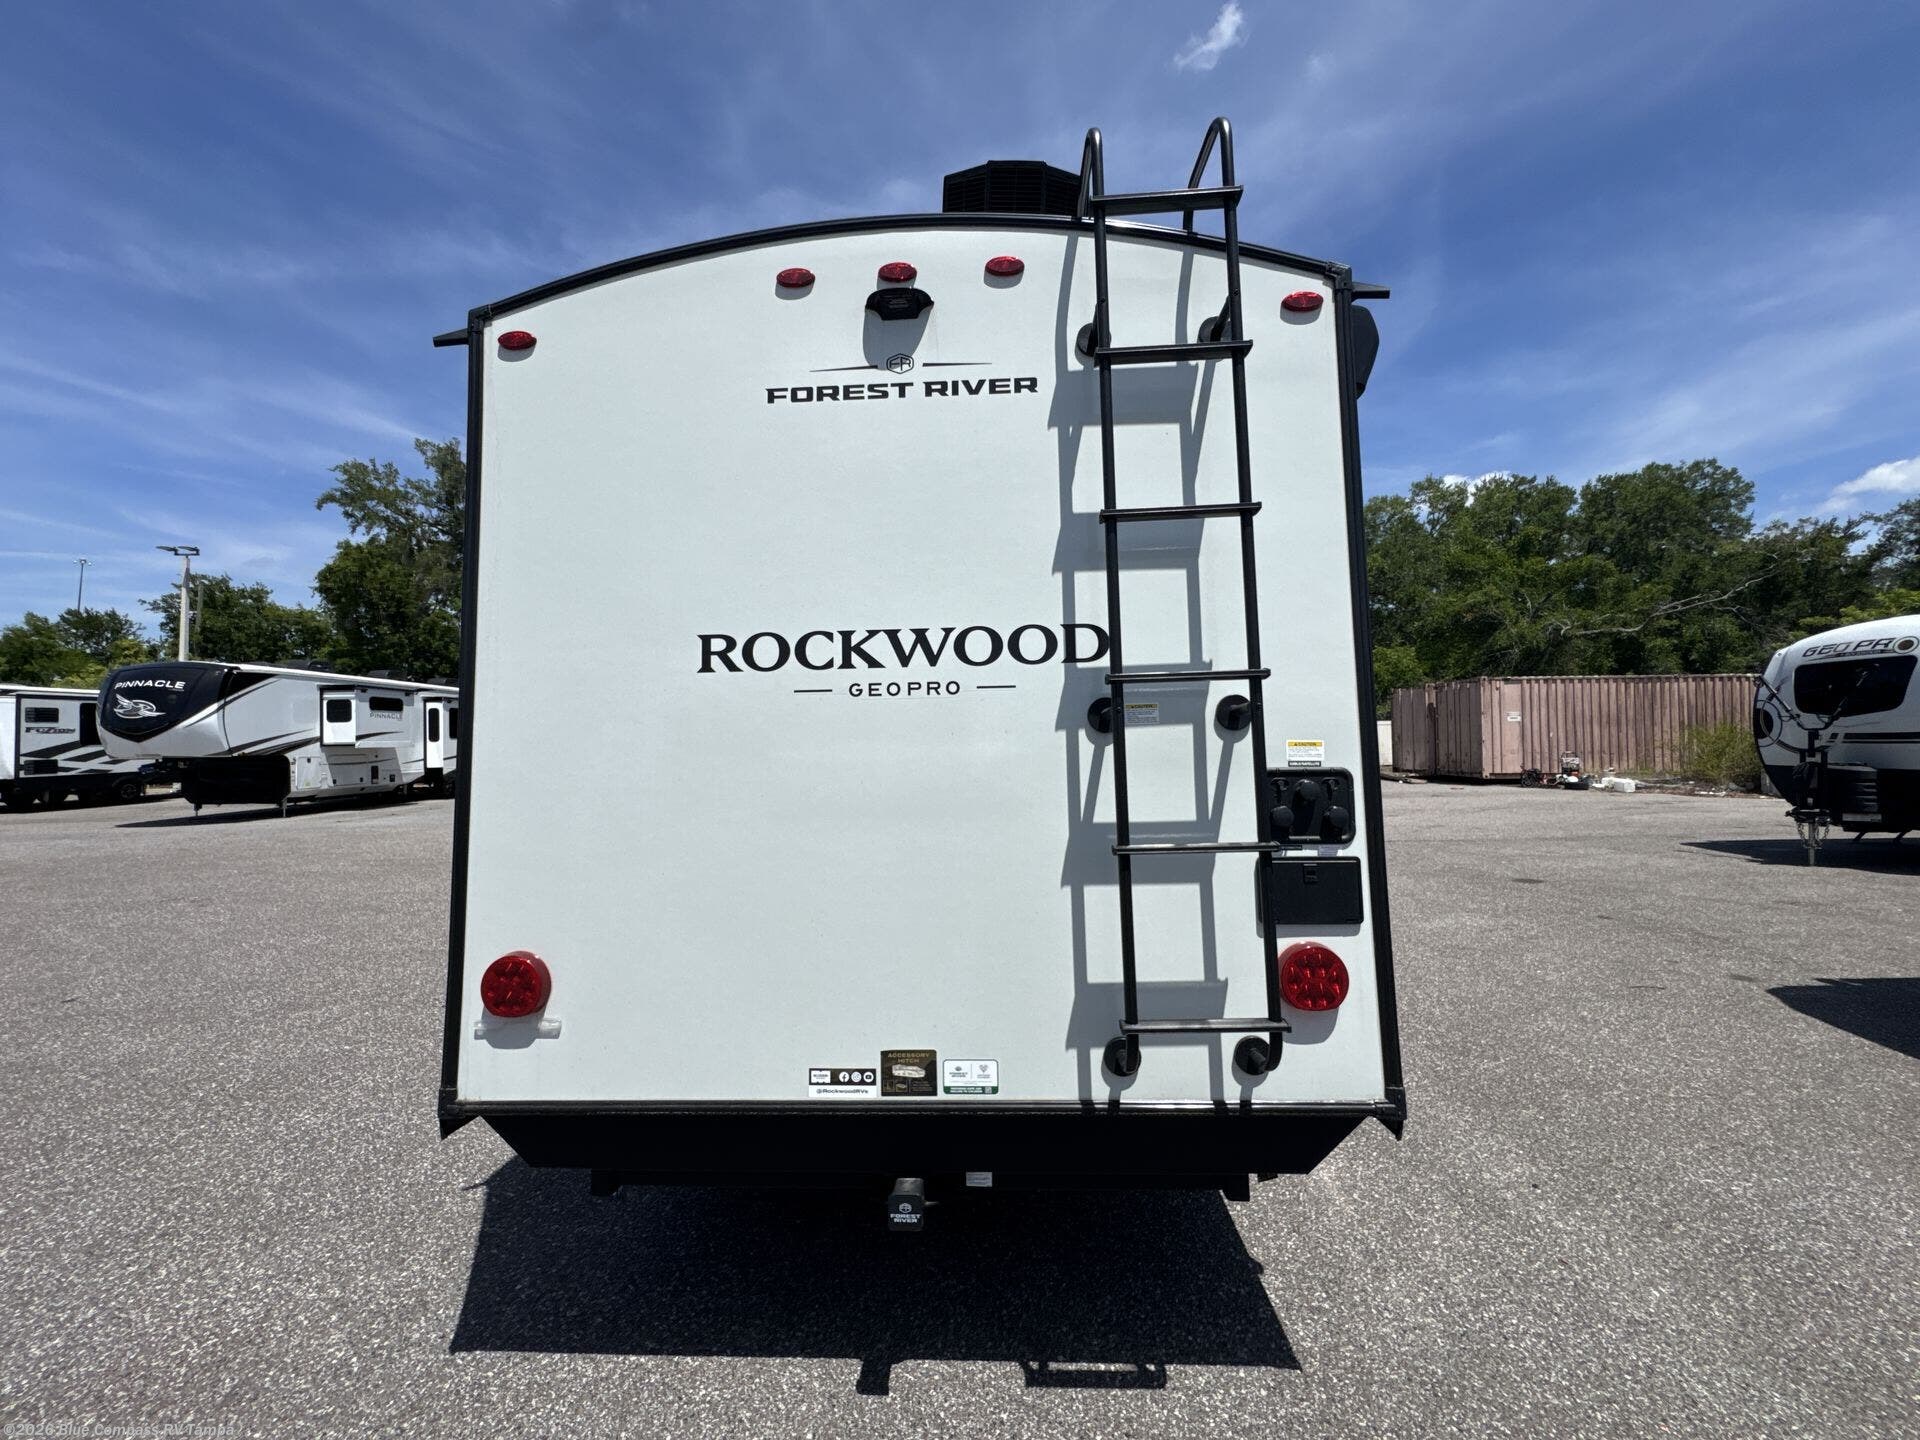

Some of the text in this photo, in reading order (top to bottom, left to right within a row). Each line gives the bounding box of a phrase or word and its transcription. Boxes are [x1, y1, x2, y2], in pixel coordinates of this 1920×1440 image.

[765, 376, 1038, 404] FOREST RIVER
[696, 623, 1110, 674] ROCKWOOD
[114, 679, 186, 690] PINNACLE
[848, 680, 961, 698] GEOPRO
[369, 712, 403, 721] PINNACLE
